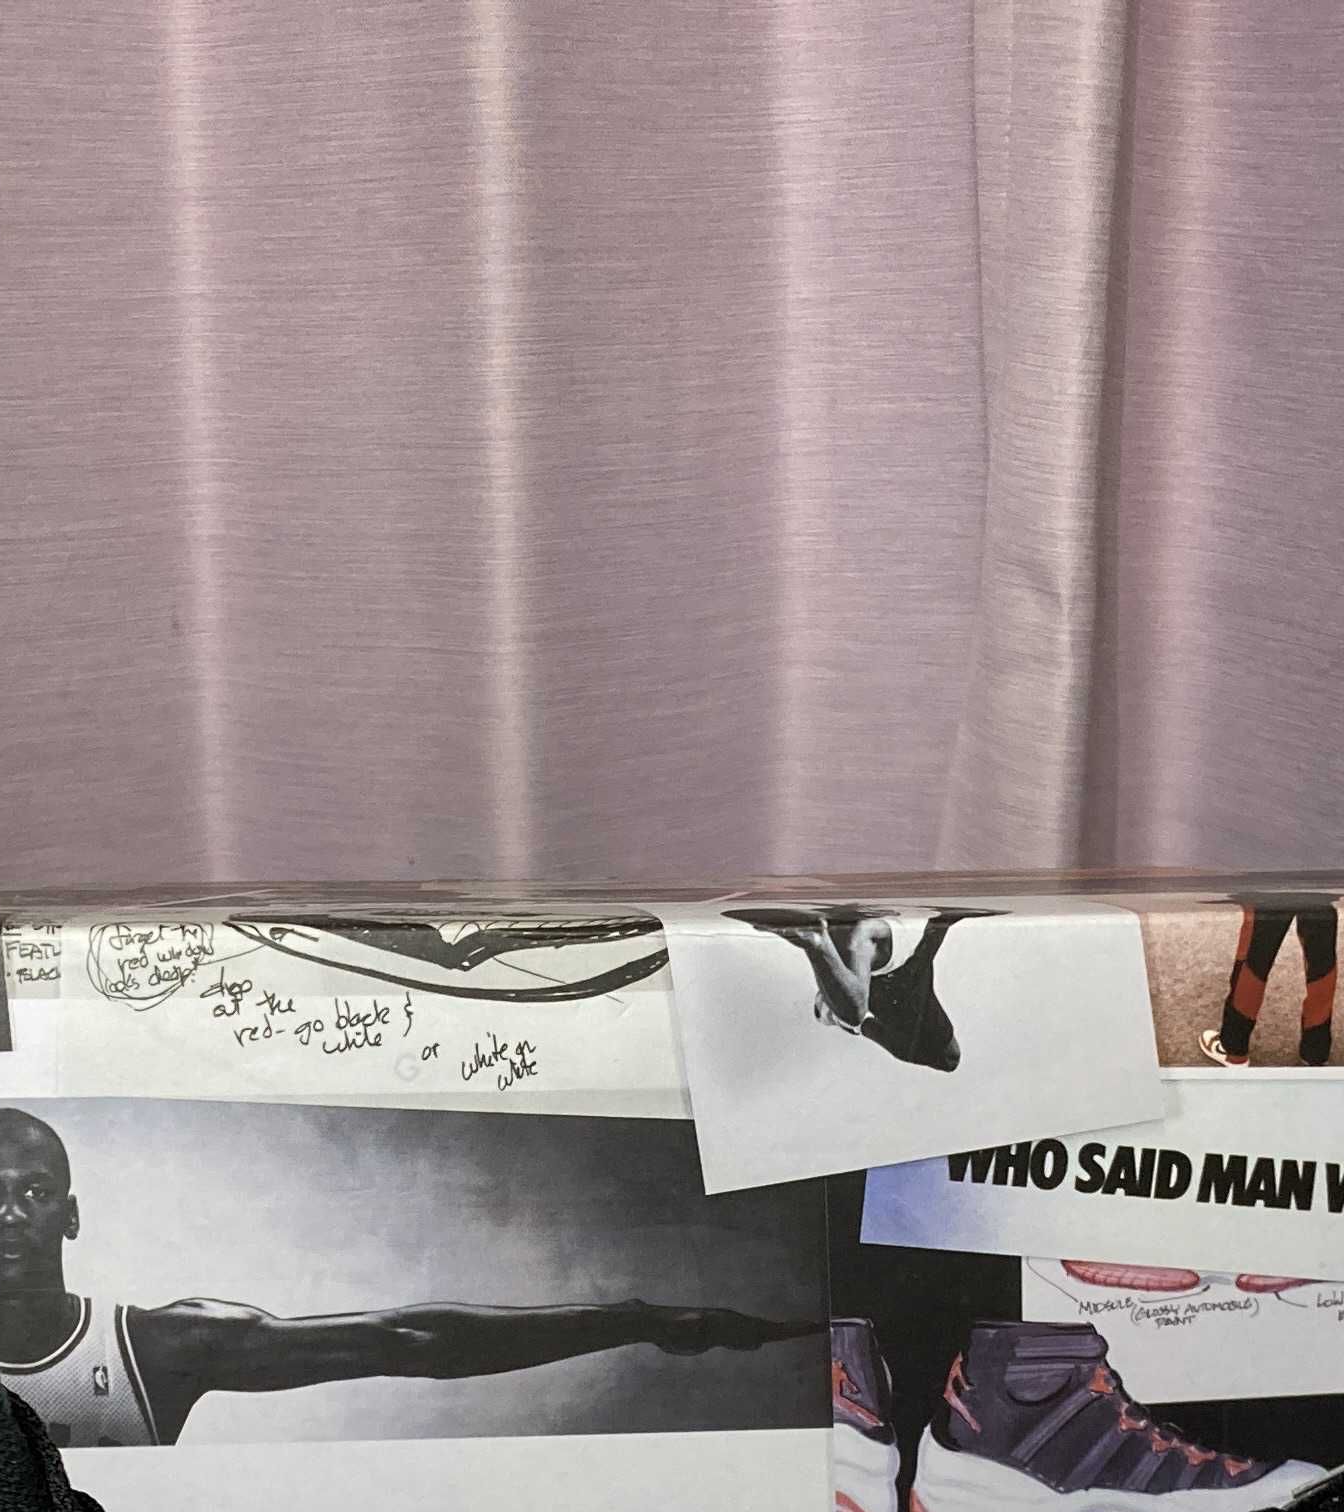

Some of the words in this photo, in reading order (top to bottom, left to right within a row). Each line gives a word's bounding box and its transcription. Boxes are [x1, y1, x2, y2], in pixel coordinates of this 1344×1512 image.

[117, 954, 149, 974] red
[213, 997, 241, 1018] at
[257, 991, 296, 1015] the
[295, 1019, 323, 1045] go
[335, 998, 391, 1030] black
[323, 1032, 383, 1054] white
[421, 1045, 440, 1061] or
[462, 1032, 508, 1081] white
[498, 1057, 539, 1092] white
[947, 1138, 1069, 1190] WHO
[1075, 1143, 1192, 1200] SAID
[1196, 1152, 1318, 1211] MAN
[1317, 1290, 1344, 1308] LOW
